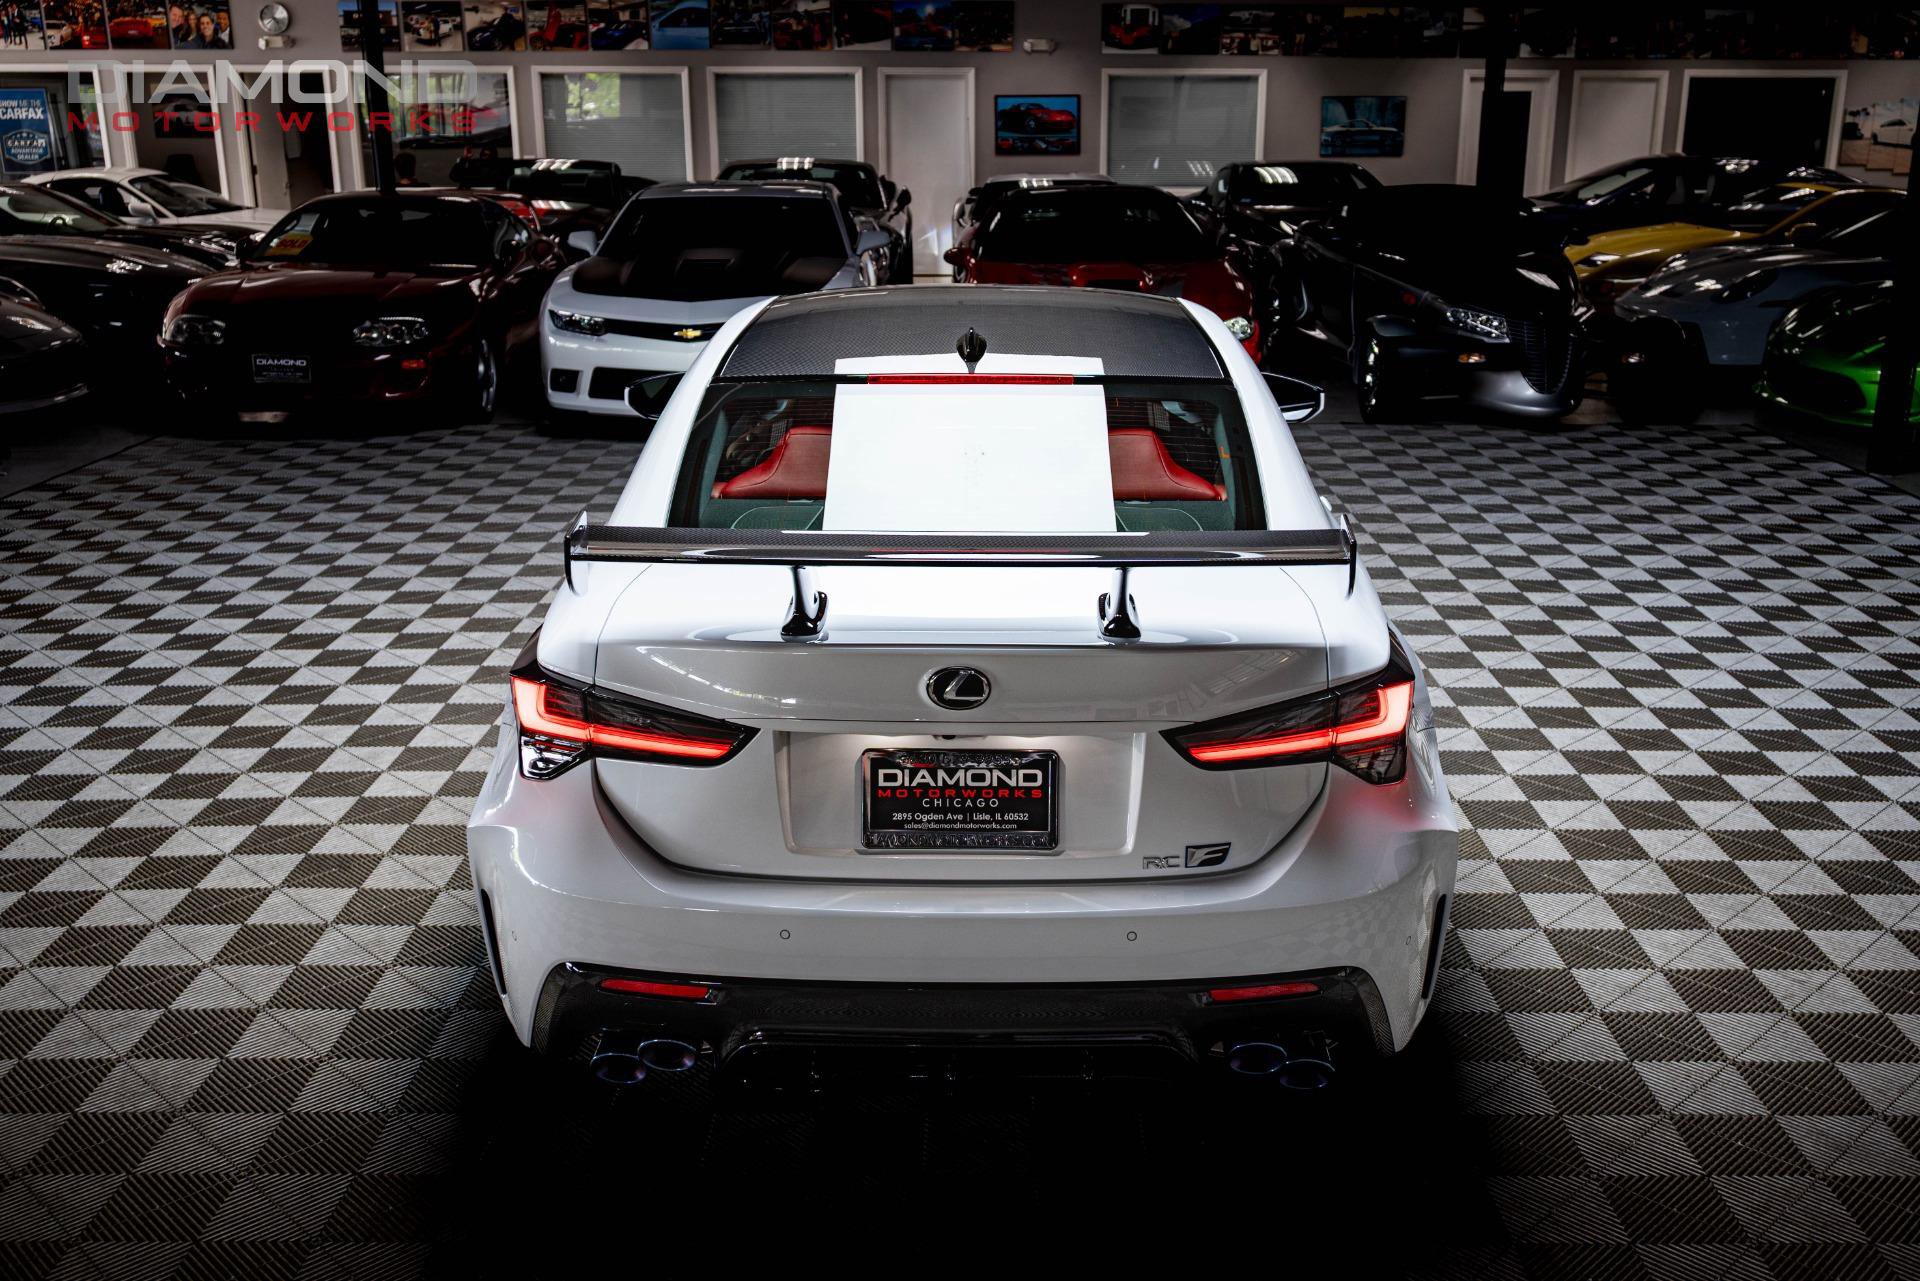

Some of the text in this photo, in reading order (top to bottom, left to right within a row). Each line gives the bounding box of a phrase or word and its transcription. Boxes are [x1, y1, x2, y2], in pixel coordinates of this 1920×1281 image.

[0, 107, 44, 120] CARFAX
[256, 358, 307, 366] DIAMOND
[878, 769, 1043, 787] DIAMOND
[878, 789, 1043, 799] MOTORWORKS
[922, 799, 999, 808] CHICAGO
[892, 812, 912, 821] 2895
[914, 812, 944, 822] Ogden
[946, 812, 964, 821] Ave
[973, 812, 993, 821] Lisle,
[995, 812, 1002, 821] IL
[1003, 812, 1029, 821] 60532
[904, 821, 1017, 830] sales@diamondmotorworks.com
[1143, 855, 1180, 869] RC
